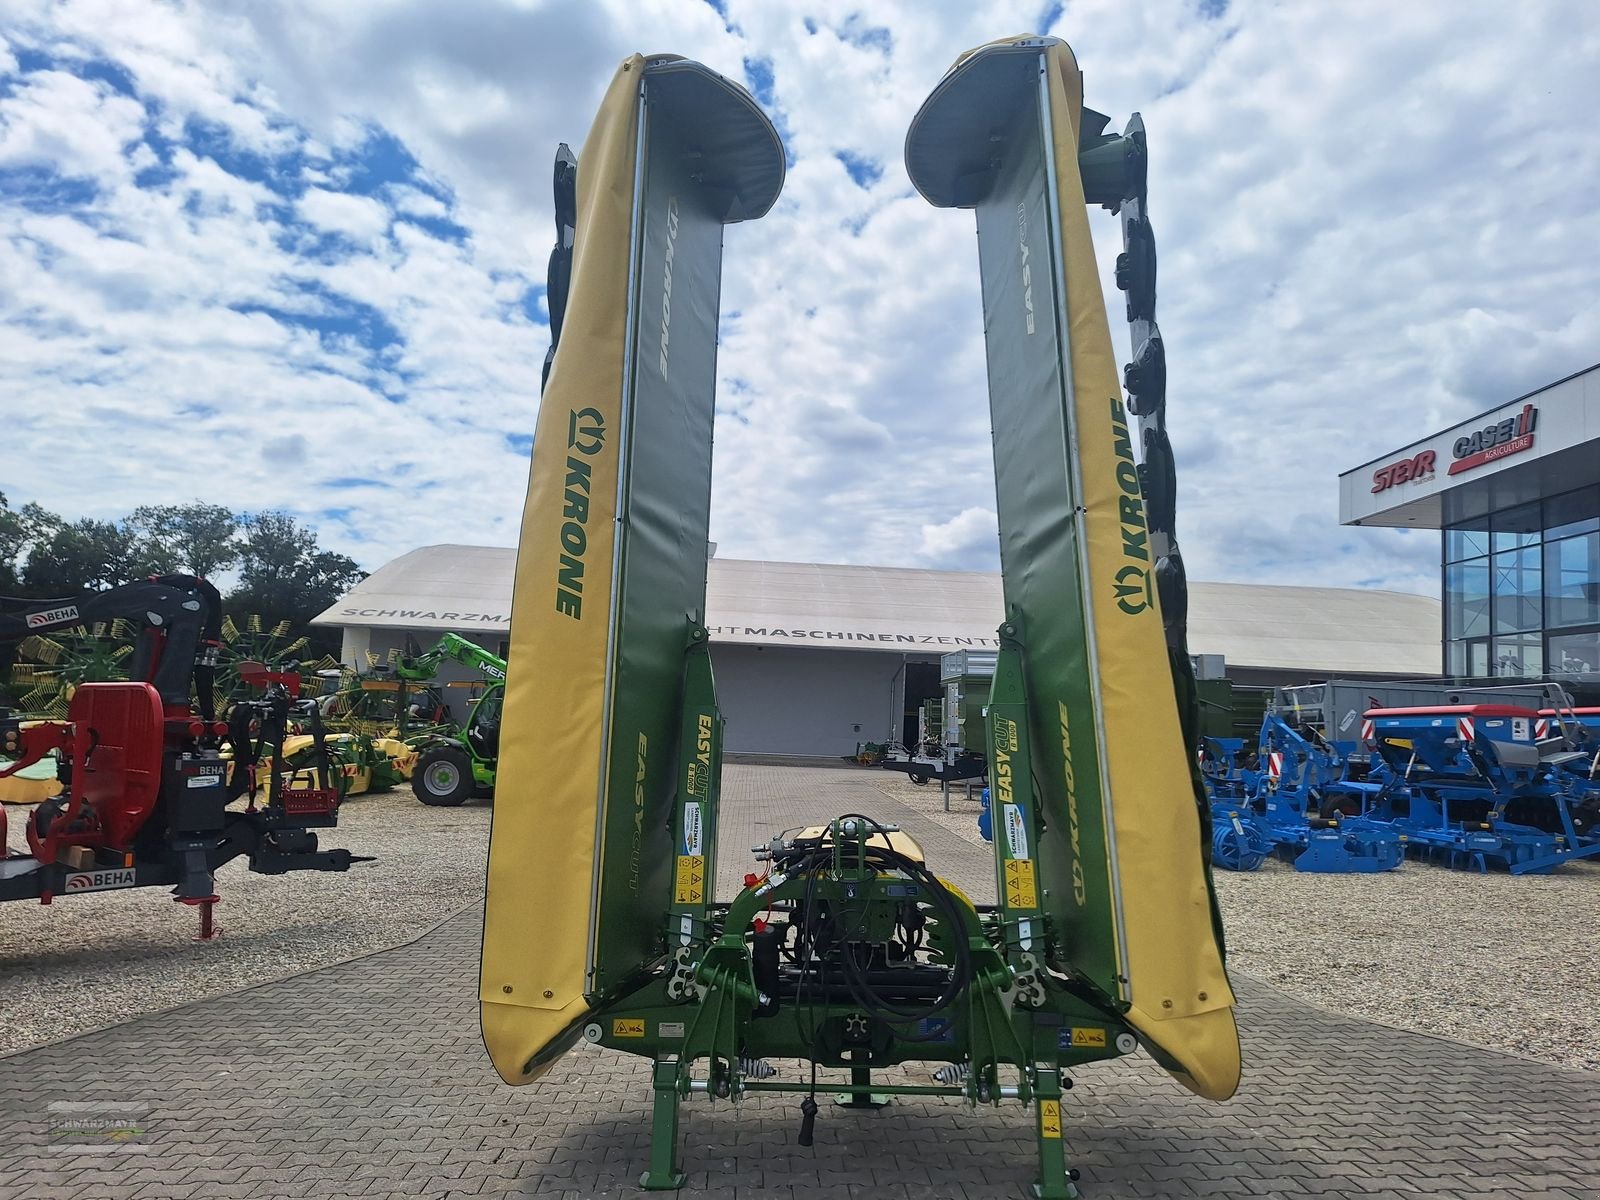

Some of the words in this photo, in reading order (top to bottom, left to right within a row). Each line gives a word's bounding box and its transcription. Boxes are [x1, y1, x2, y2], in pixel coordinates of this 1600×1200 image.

[659, 235, 675, 382] KRONE
[1452, 417, 1514, 459] CASE
[1485, 437, 1528, 460] AGRICULTURE
[1109, 397, 1149, 562] KRONE
[1371, 449, 1436, 493] STEYR
[556, 455, 591, 620] KRONE
[47, 608, 77, 621] BEHA
[199, 766, 225, 775] BEHA
[694, 714, 712, 802] EASYCUT
[994, 713, 1013, 803] EASYCUT
[1059, 700, 1081, 858] KRONE
[1008, 811, 1017, 854] SCHWARZMAYR
[94, 871, 133, 886] BEHA
